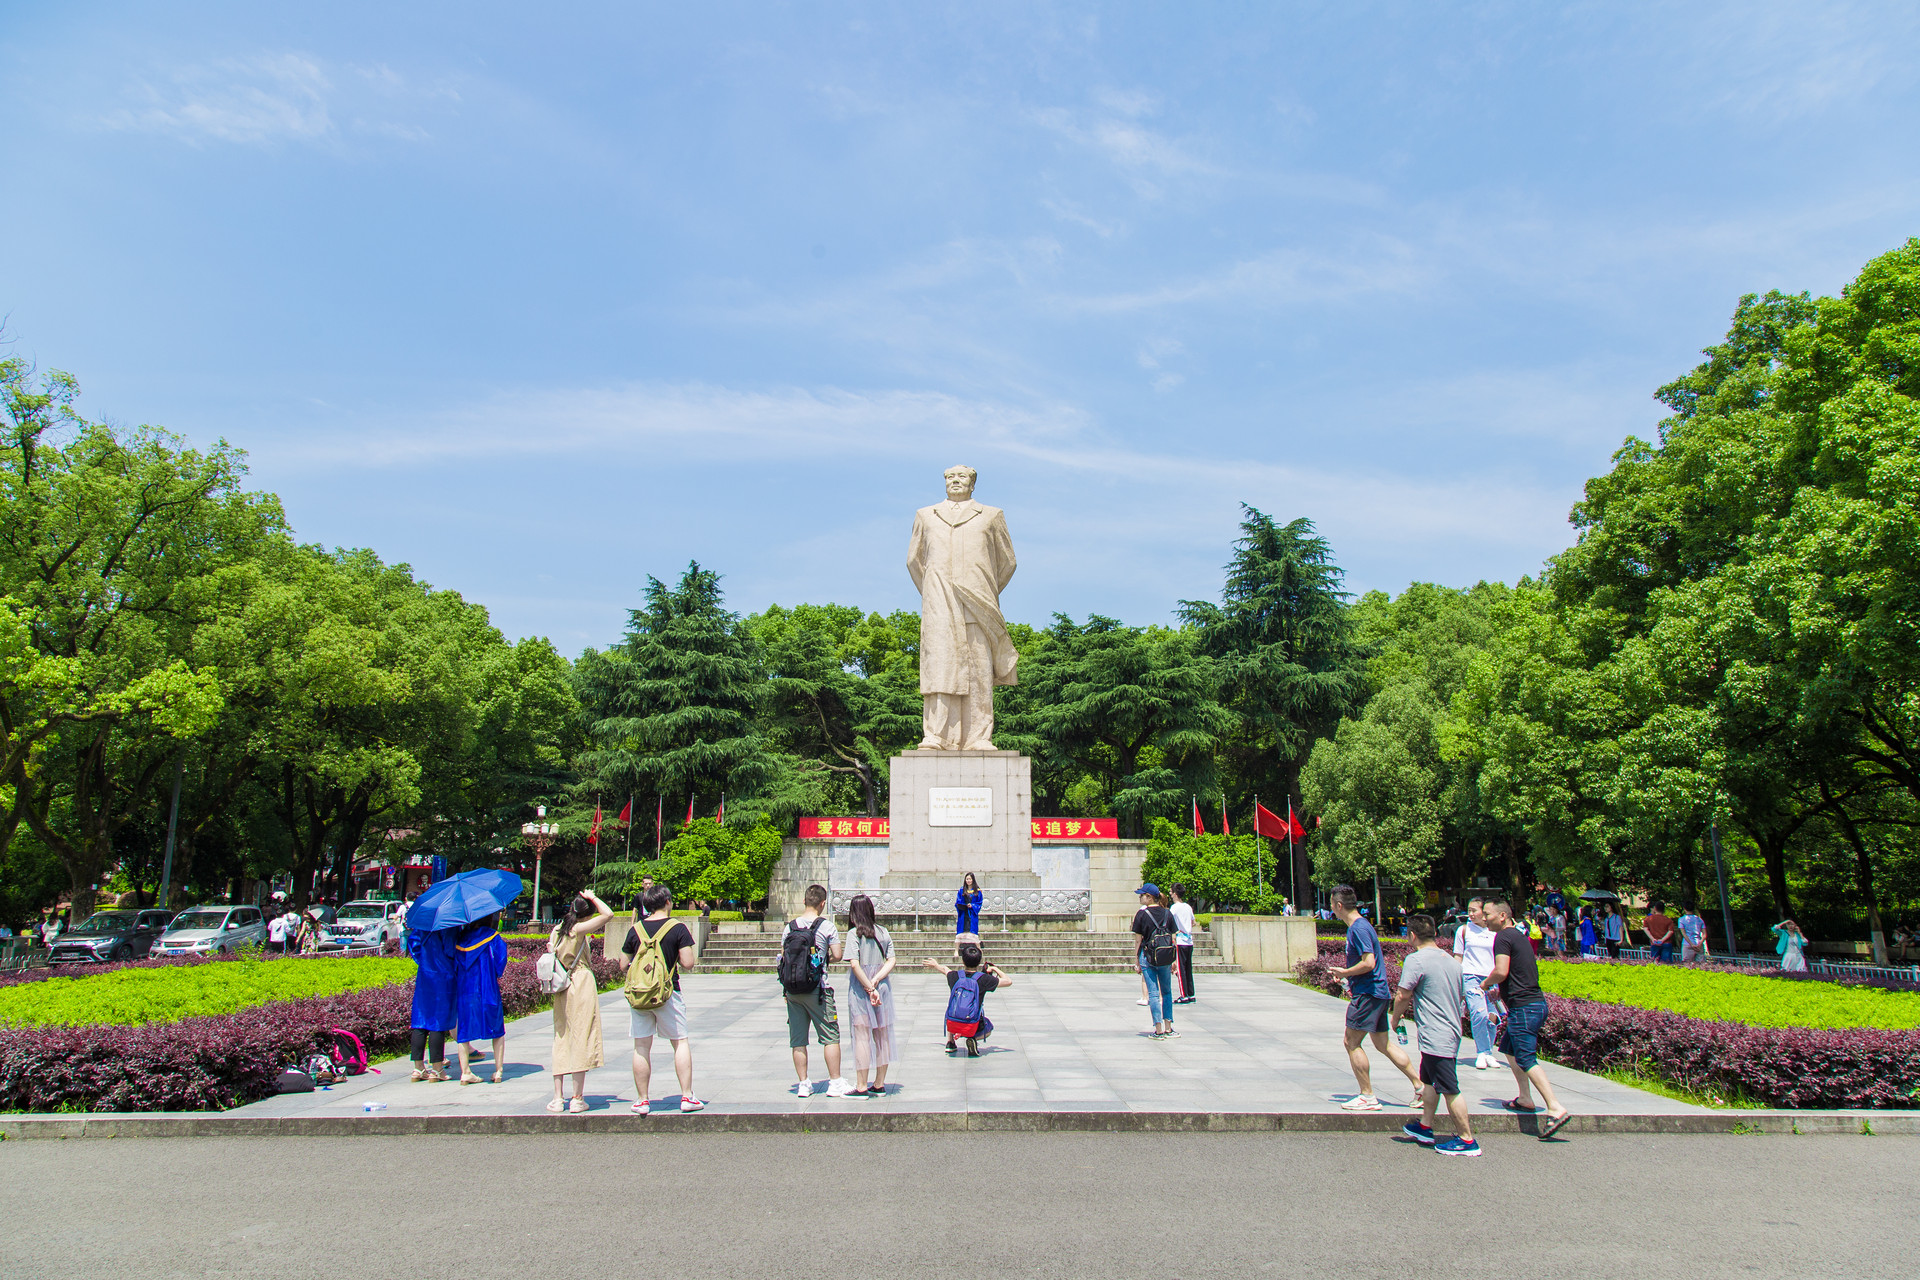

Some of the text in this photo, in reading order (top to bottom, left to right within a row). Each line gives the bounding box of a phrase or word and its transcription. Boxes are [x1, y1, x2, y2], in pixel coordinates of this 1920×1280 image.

[817, 820, 1101, 836] 爱你何止 飞追梦人
